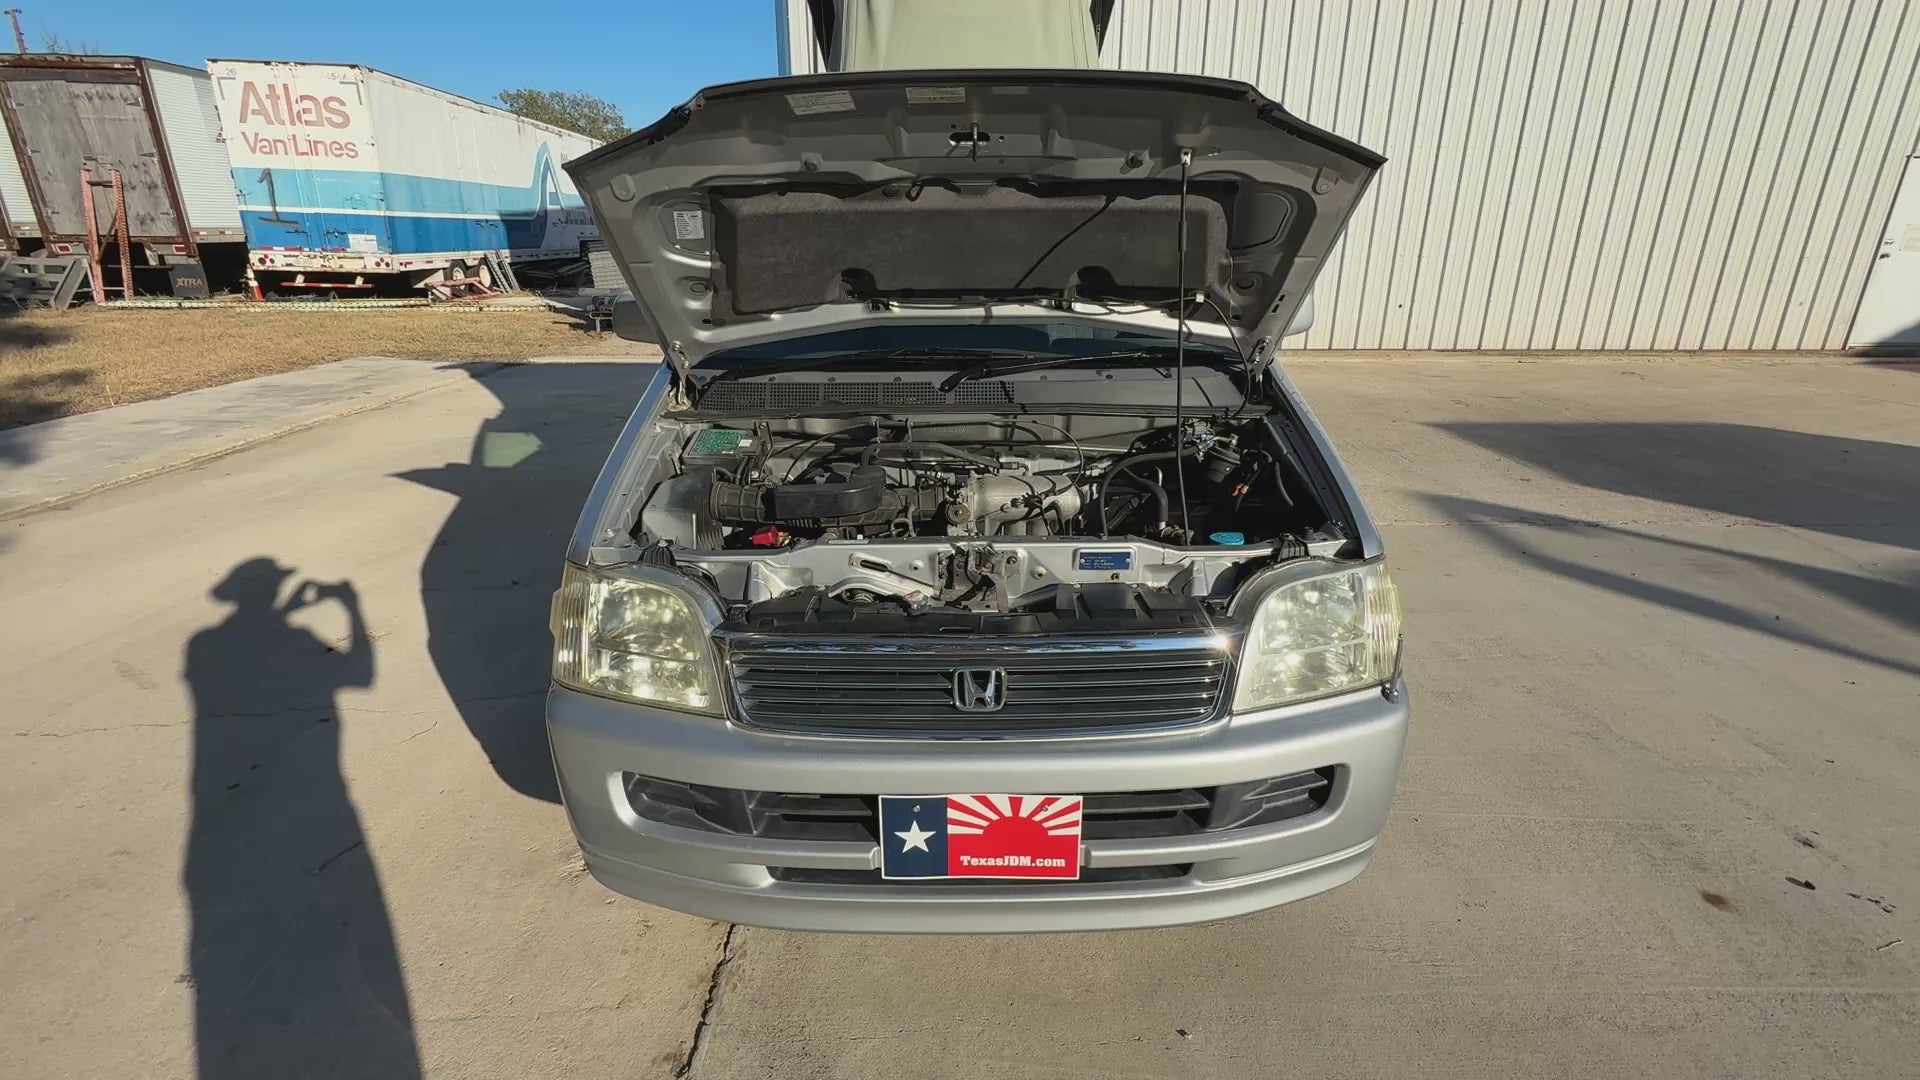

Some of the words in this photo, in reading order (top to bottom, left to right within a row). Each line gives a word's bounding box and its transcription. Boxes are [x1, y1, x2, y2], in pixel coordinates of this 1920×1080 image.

[225, 67, 237, 76] 26
[239, 81, 351, 129] Atlas
[241, 131, 289, 155] Van
[291, 133, 359, 159] Lines
[176, 277, 204, 288] XTRA
[960, 855, 1067, 868] TexasJDM.com
